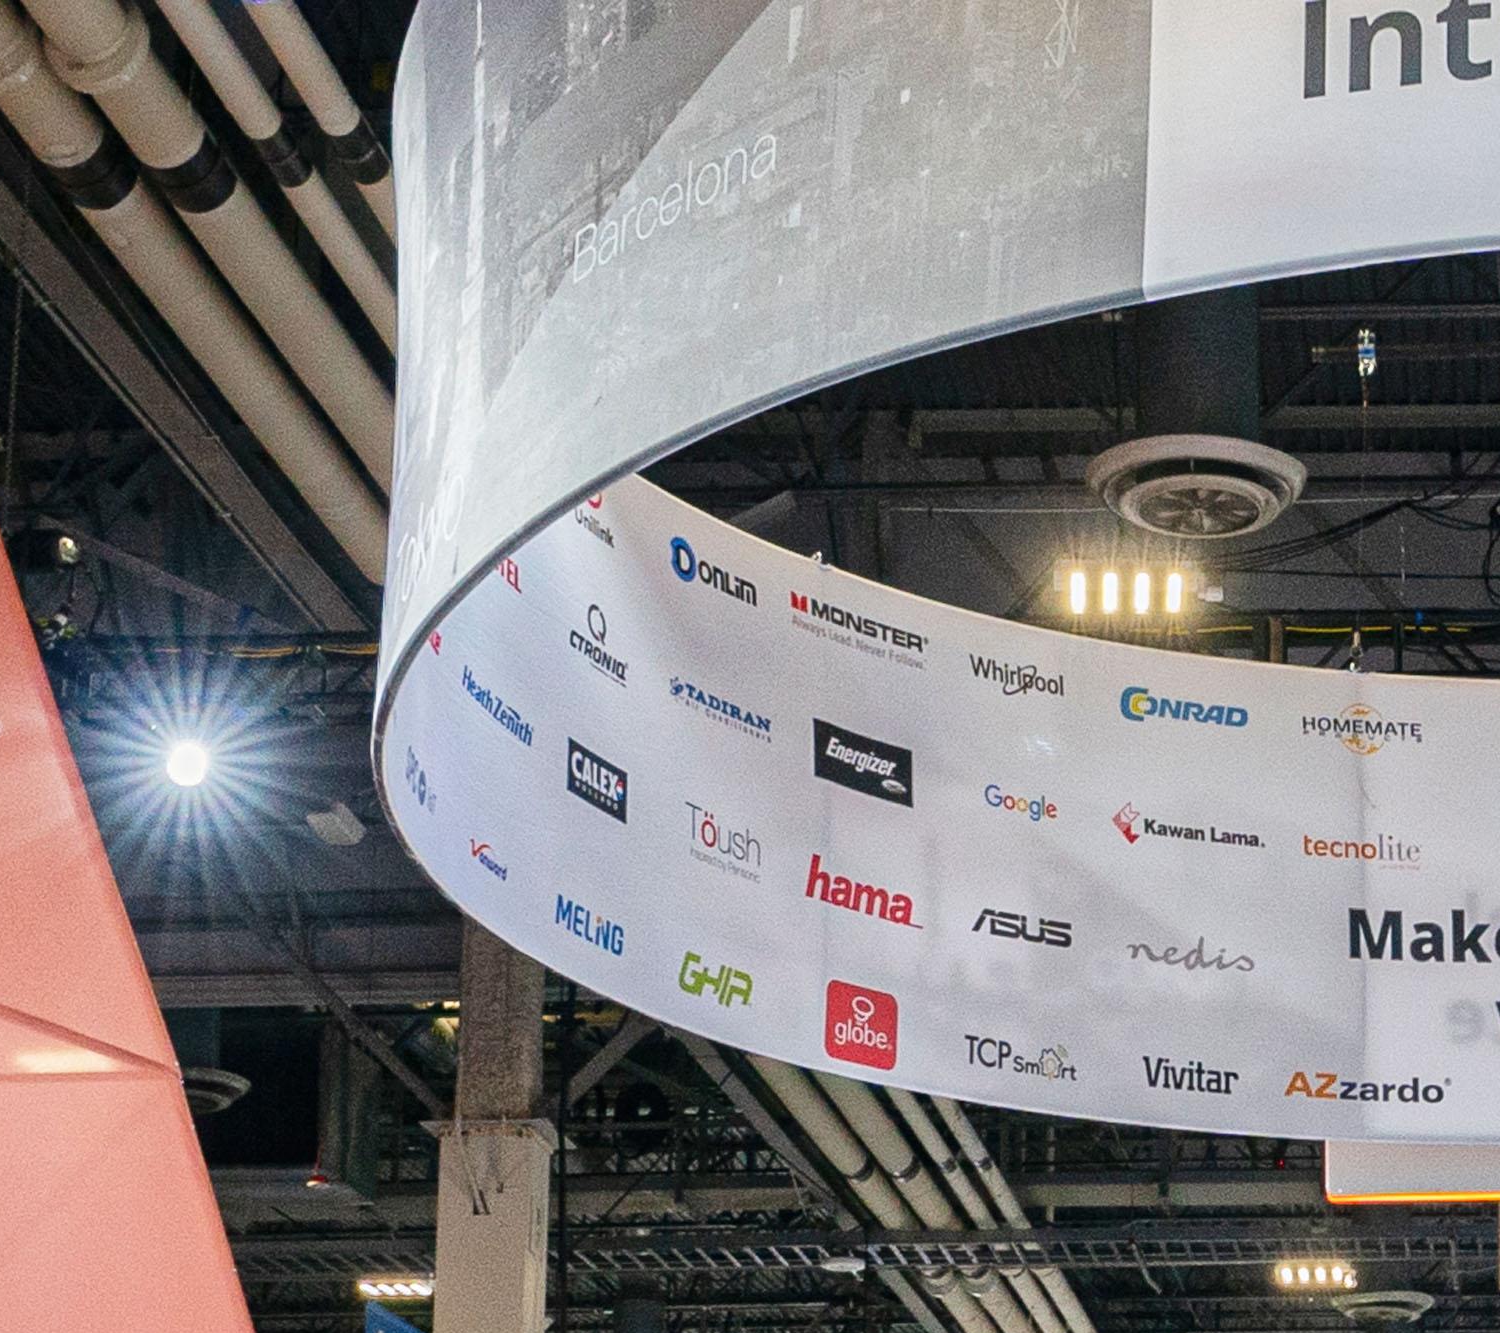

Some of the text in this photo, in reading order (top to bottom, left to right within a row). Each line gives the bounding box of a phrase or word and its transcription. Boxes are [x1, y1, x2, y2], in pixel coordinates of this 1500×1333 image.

[571, 131, 778, 284] Barcelona
[811, 599, 924, 653] MONSTER
[569, 630, 628, 681] CTRONIQ
[970, 653, 1064, 696] Whirlpool
[687, 683, 772, 733] TADIRAN
[1120, 686, 1248, 728] CONRAD
[1302, 716, 1422, 738] HOMEMATE
[571, 751, 619, 800] CALEX
[826, 737, 897, 779] Energizer
[984, 784, 1058, 821] Google
[685, 801, 760, 866] Töush
[1144, 817, 1203, 841] Kawan
[1303, 833, 1420, 863] tecnolite
[805, 855, 921, 928] hama
[972, 908, 1072, 947] ASUS
[1128, 937, 1255, 973] nedis
[678, 950, 753, 1007] GHIA
[834, 1016, 889, 1051] globe
[966, 1035, 1011, 1067] TCP
[1142, 1056, 1239, 1095] Vivitar
[1285, 1072, 1445, 1103] AZzardo
